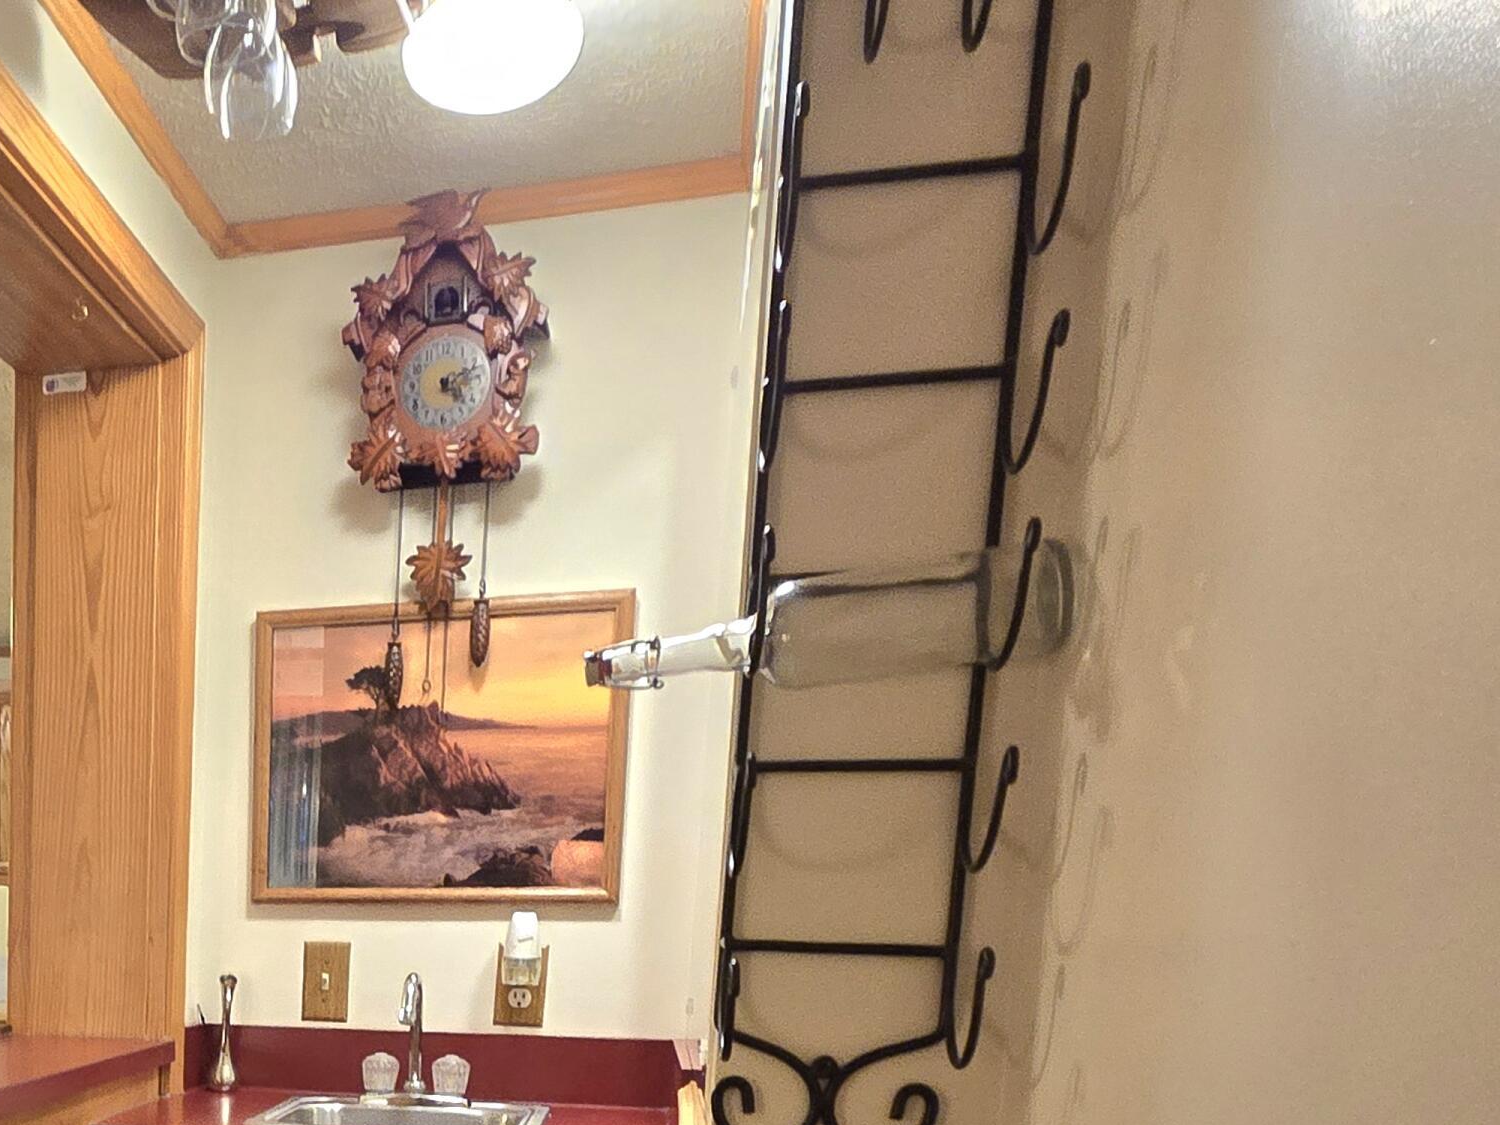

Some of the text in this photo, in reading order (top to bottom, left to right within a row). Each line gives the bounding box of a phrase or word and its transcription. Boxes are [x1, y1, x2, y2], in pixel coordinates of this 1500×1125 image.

[425, 348, 433, 361] 11
[441, 343, 451, 355] 12
[412, 363, 422, 375] 10
[411, 399, 419, 411] 8
